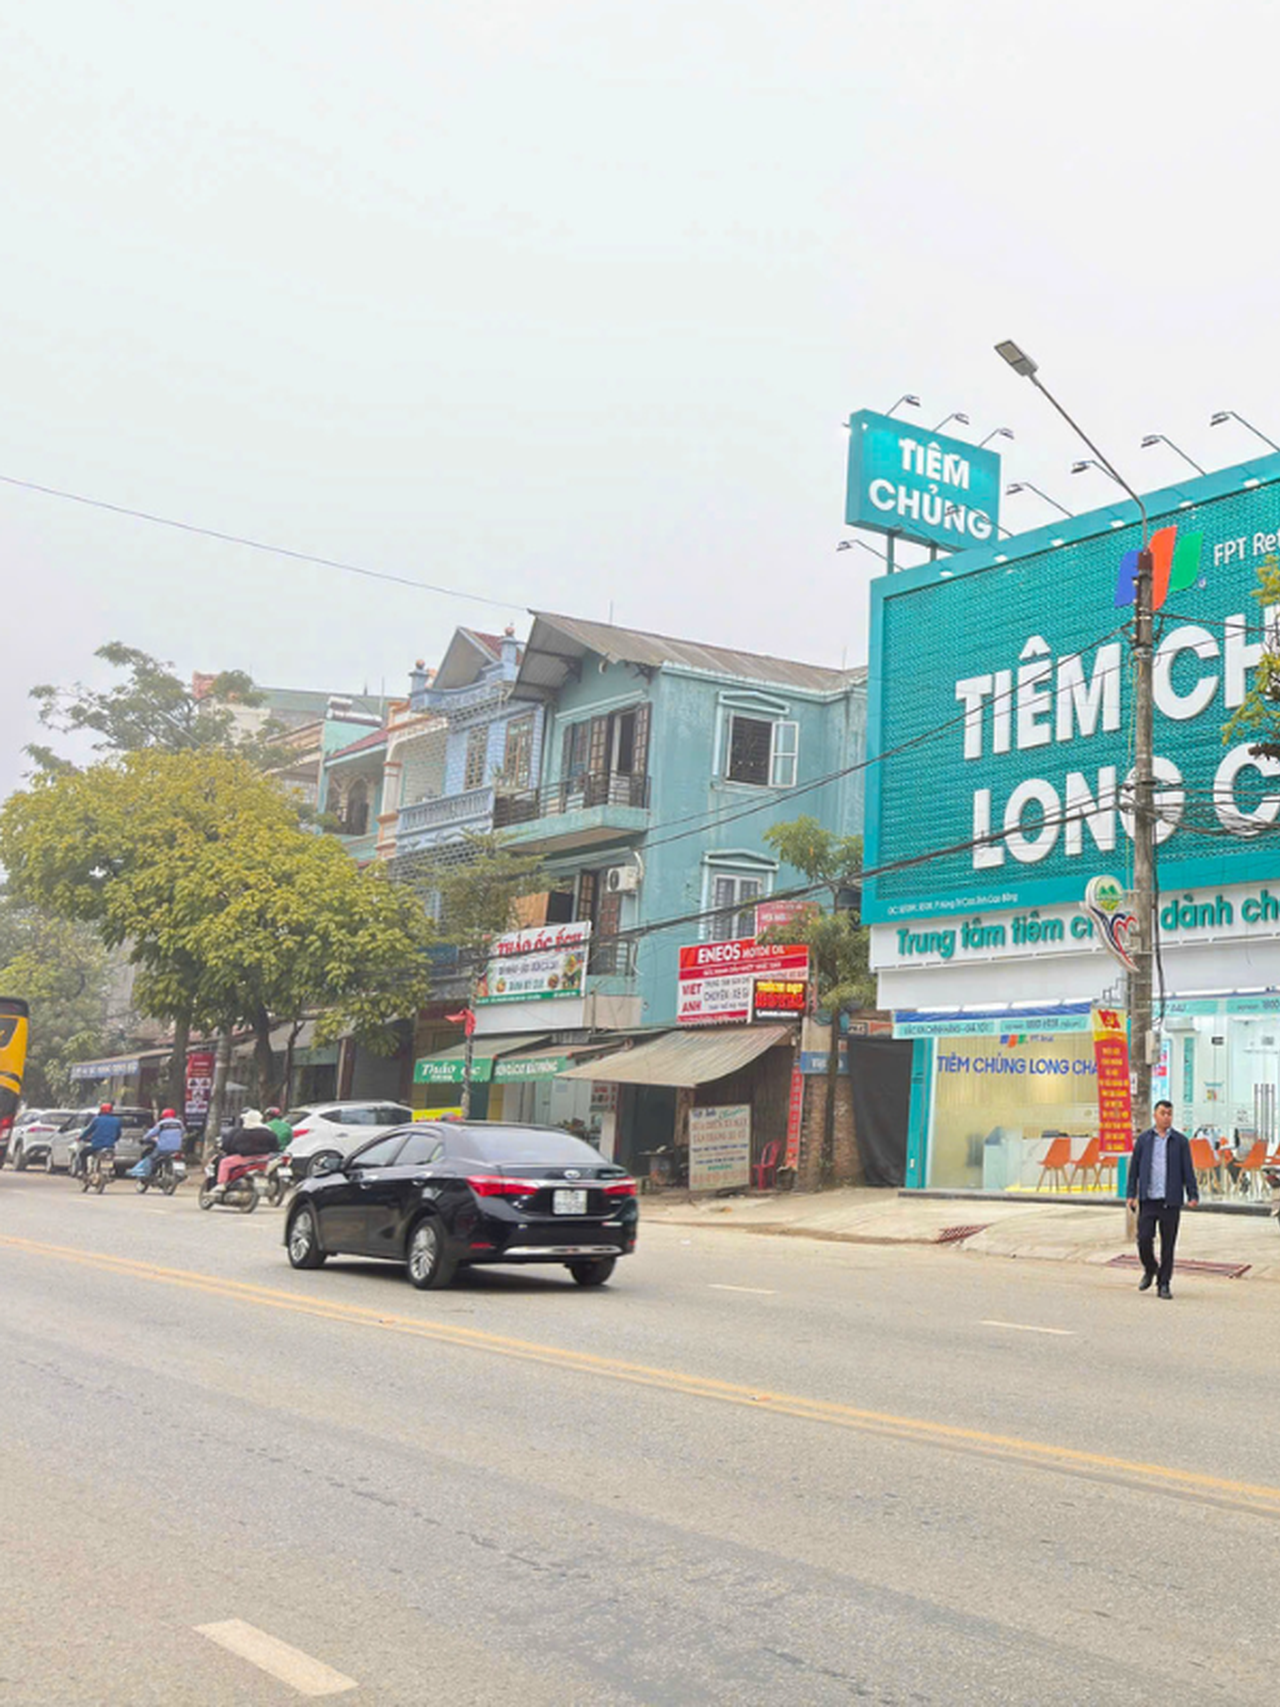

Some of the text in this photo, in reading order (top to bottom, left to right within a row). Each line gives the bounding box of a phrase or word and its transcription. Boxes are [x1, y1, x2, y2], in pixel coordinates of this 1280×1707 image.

[899, 438, 970, 491] TIÊM
[868, 478, 993, 541] CHỦNG
[1213, 536, 1247, 566] FPT
[955, 635, 1122, 760] TIÊM
[971, 756, 1184, 870] LONG
[697, 943, 741, 965] ENEOS
[772, 944, 786, 956] OIL
[896, 927, 956, 960] Trung
[961, 916, 1006, 950] tâm
[1011, 909, 1064, 945] tiêm
[1160, 892, 1234, 932] dành
[937, 1052, 970, 1073] TIÊM
[973, 1053, 1027, 1075] CHỦNG
[1029, 1058, 1069, 1075] LONG
